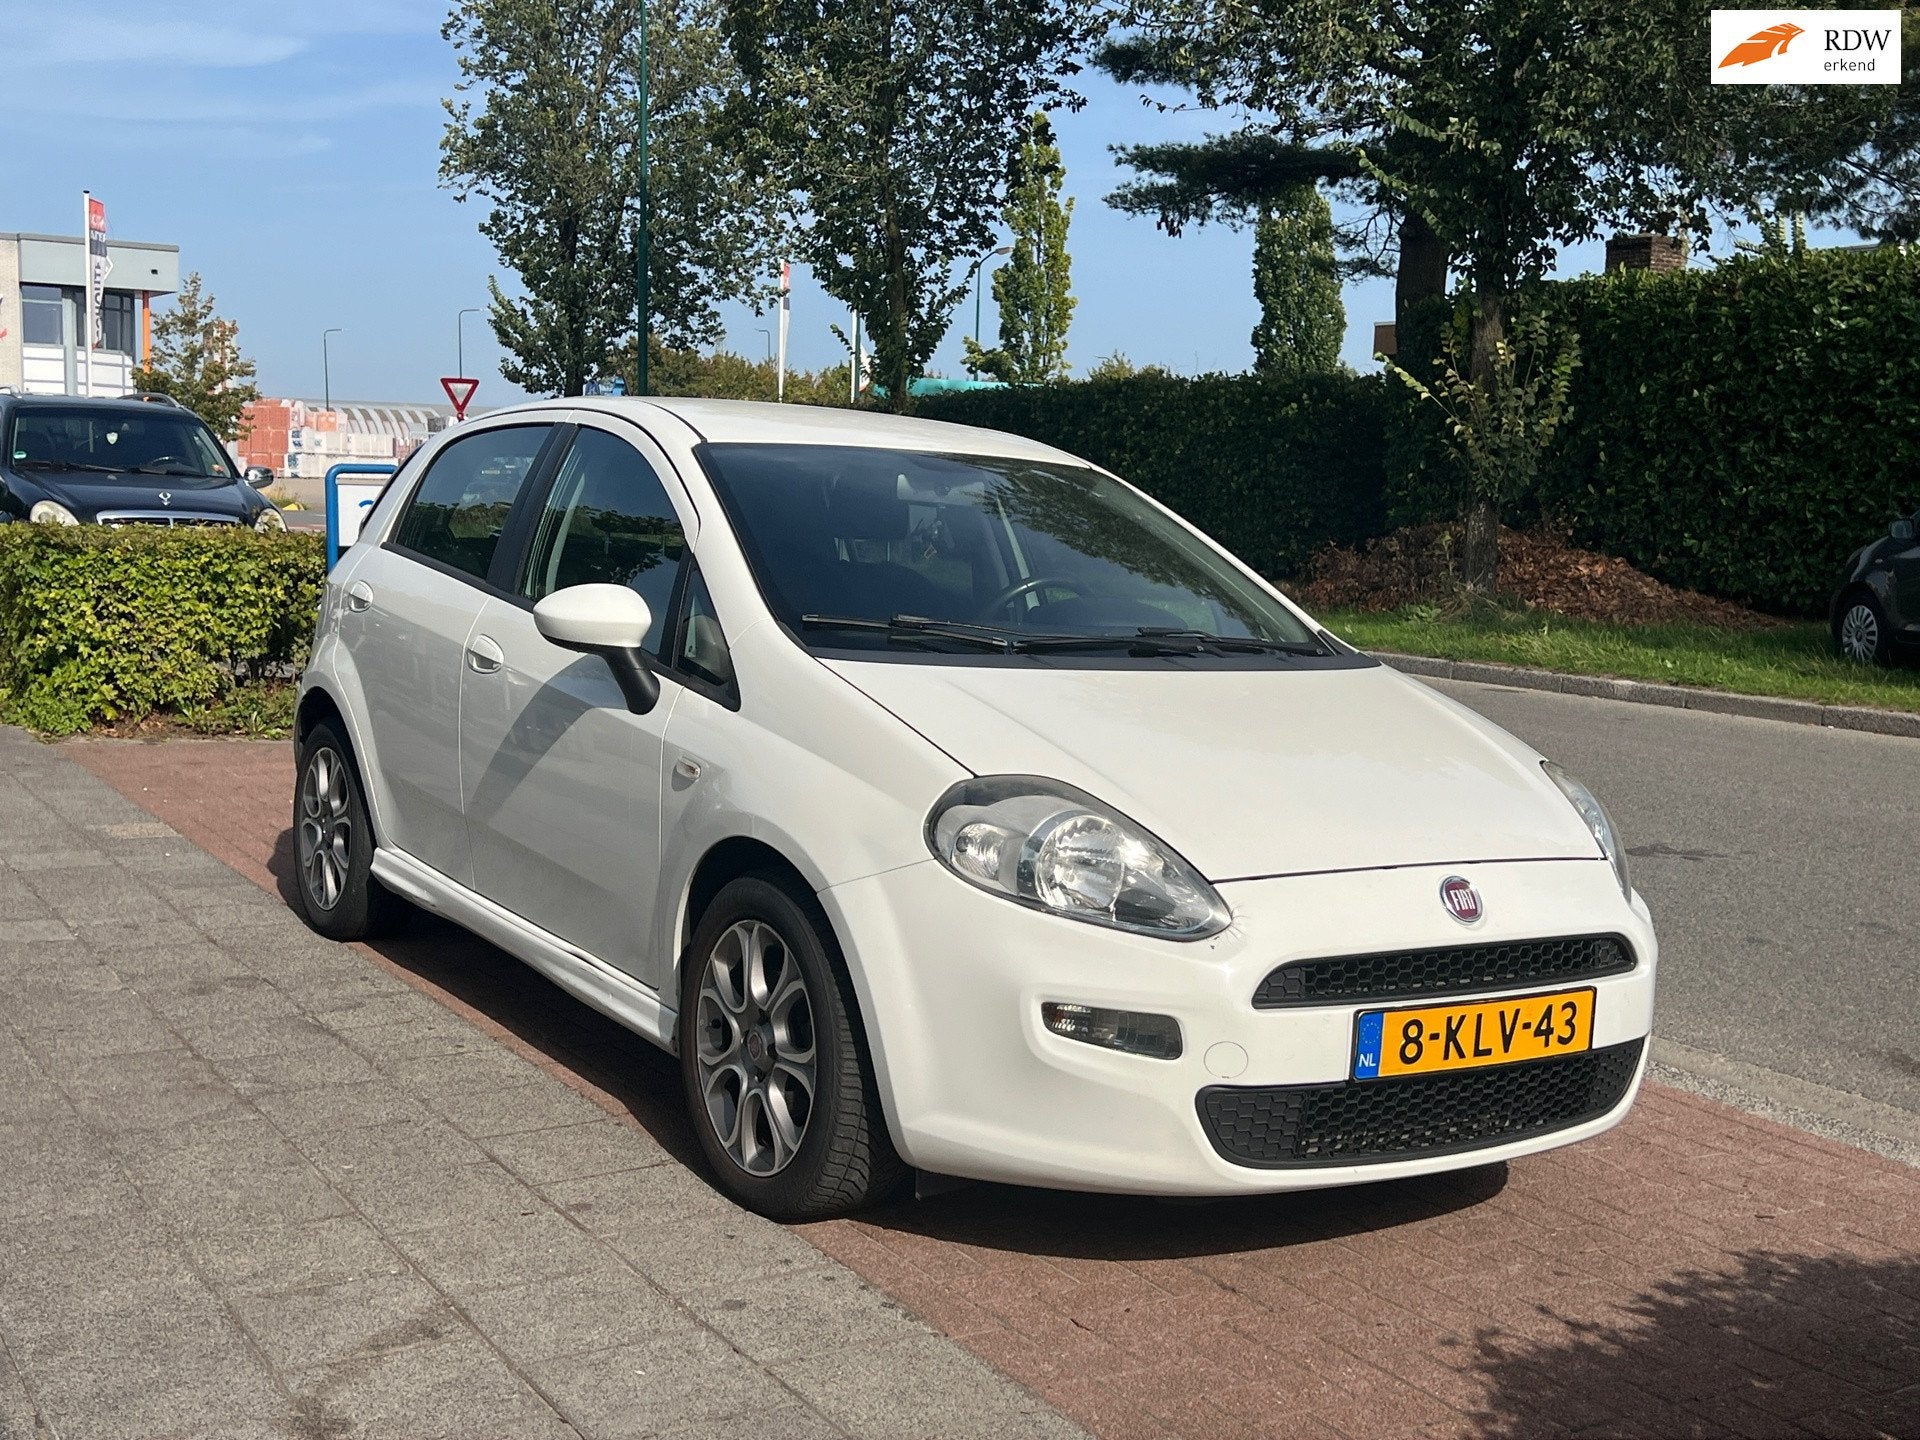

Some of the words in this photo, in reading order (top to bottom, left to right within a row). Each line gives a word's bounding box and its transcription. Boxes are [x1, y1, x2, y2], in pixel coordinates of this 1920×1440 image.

[1449, 888, 1476, 911] FIAT
[1399, 1000, 1577, 1065] 8-KLV-43
[1358, 1053, 1377, 1068] NL
